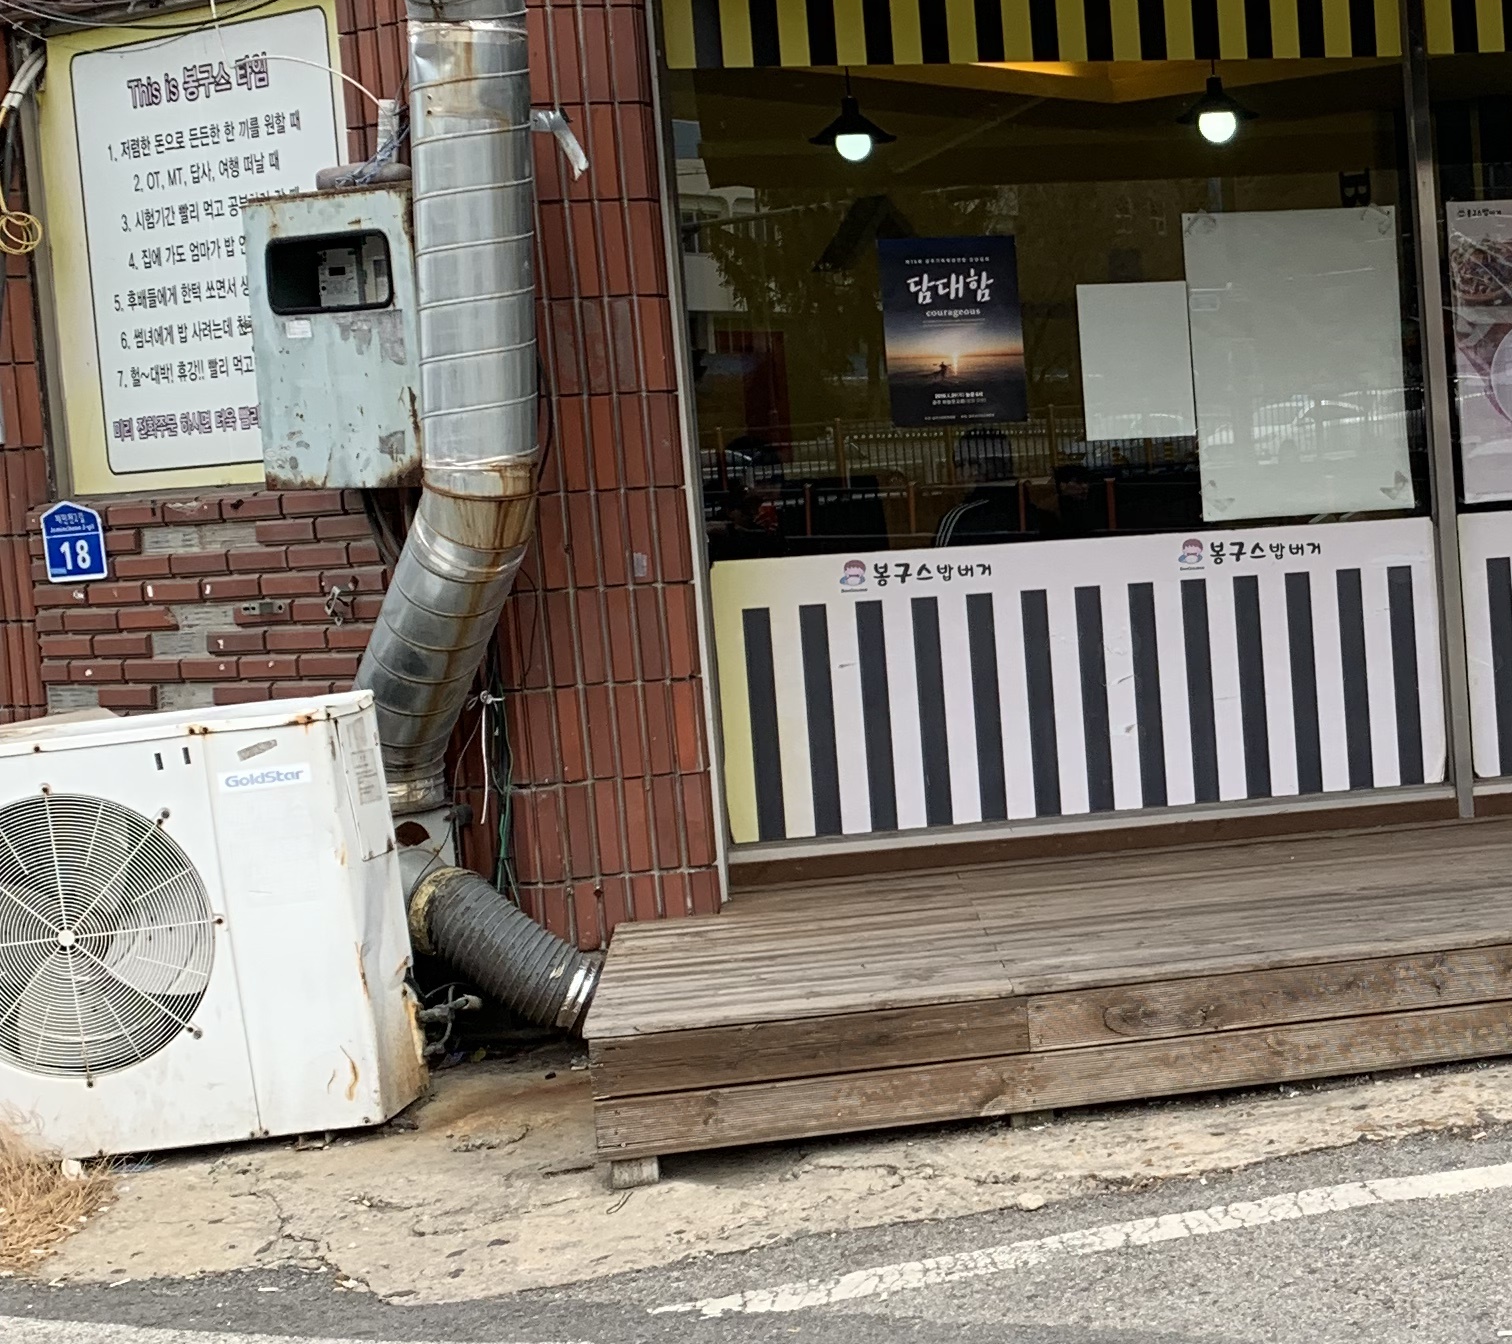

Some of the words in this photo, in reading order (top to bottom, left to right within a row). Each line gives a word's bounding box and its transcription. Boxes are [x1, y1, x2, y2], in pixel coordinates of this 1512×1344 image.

[127, 77, 162, 109] This
[164, 72, 180, 103] is
[183, 61, 233, 102] 봉구스
[107, 144, 118, 162] 1.
[120, 135, 152, 160] 저렴한
[154, 129, 186, 155] 돈으로
[188, 123, 221, 149] 든든한
[223, 120, 235, 143] 한
[263, 111, 286, 135] 원할
[133, 172, 144, 193] 2.
[146, 170, 165, 190] OT,
[167, 166, 187, 187] MT,
[218, 155, 240, 179] 여행
[121, 213, 132, 233] 3.
[134, 205, 176, 231] 시험기간
[177, 201, 200, 225] 빨리
[203, 198, 225, 221] 먹고
[128, 252, 139, 270] 4.
[141, 246, 163, 270] 집에
[165, 244, 187, 266] 가도
[189, 237, 221, 263] 엄마가
[224, 235, 235, 258] 밥
[113, 294, 125, 312] 5.
[126, 284, 178, 311] 후배들에게
[906, 267, 994, 305] 담대함
[925, 307, 981, 318] courageous
[120, 331, 131, 350] 6.
[177, 322, 188, 344] 밥
[191, 317, 234, 342] 사려는데
[117, 370, 128, 389] 7.
[59, 539, 92, 571] 18
[1209, 540, 1323, 565] 봉구스밥버거
[872, 562, 993, 587] 봉구스밥버거
[225, 769, 305, 788] GoldStar
